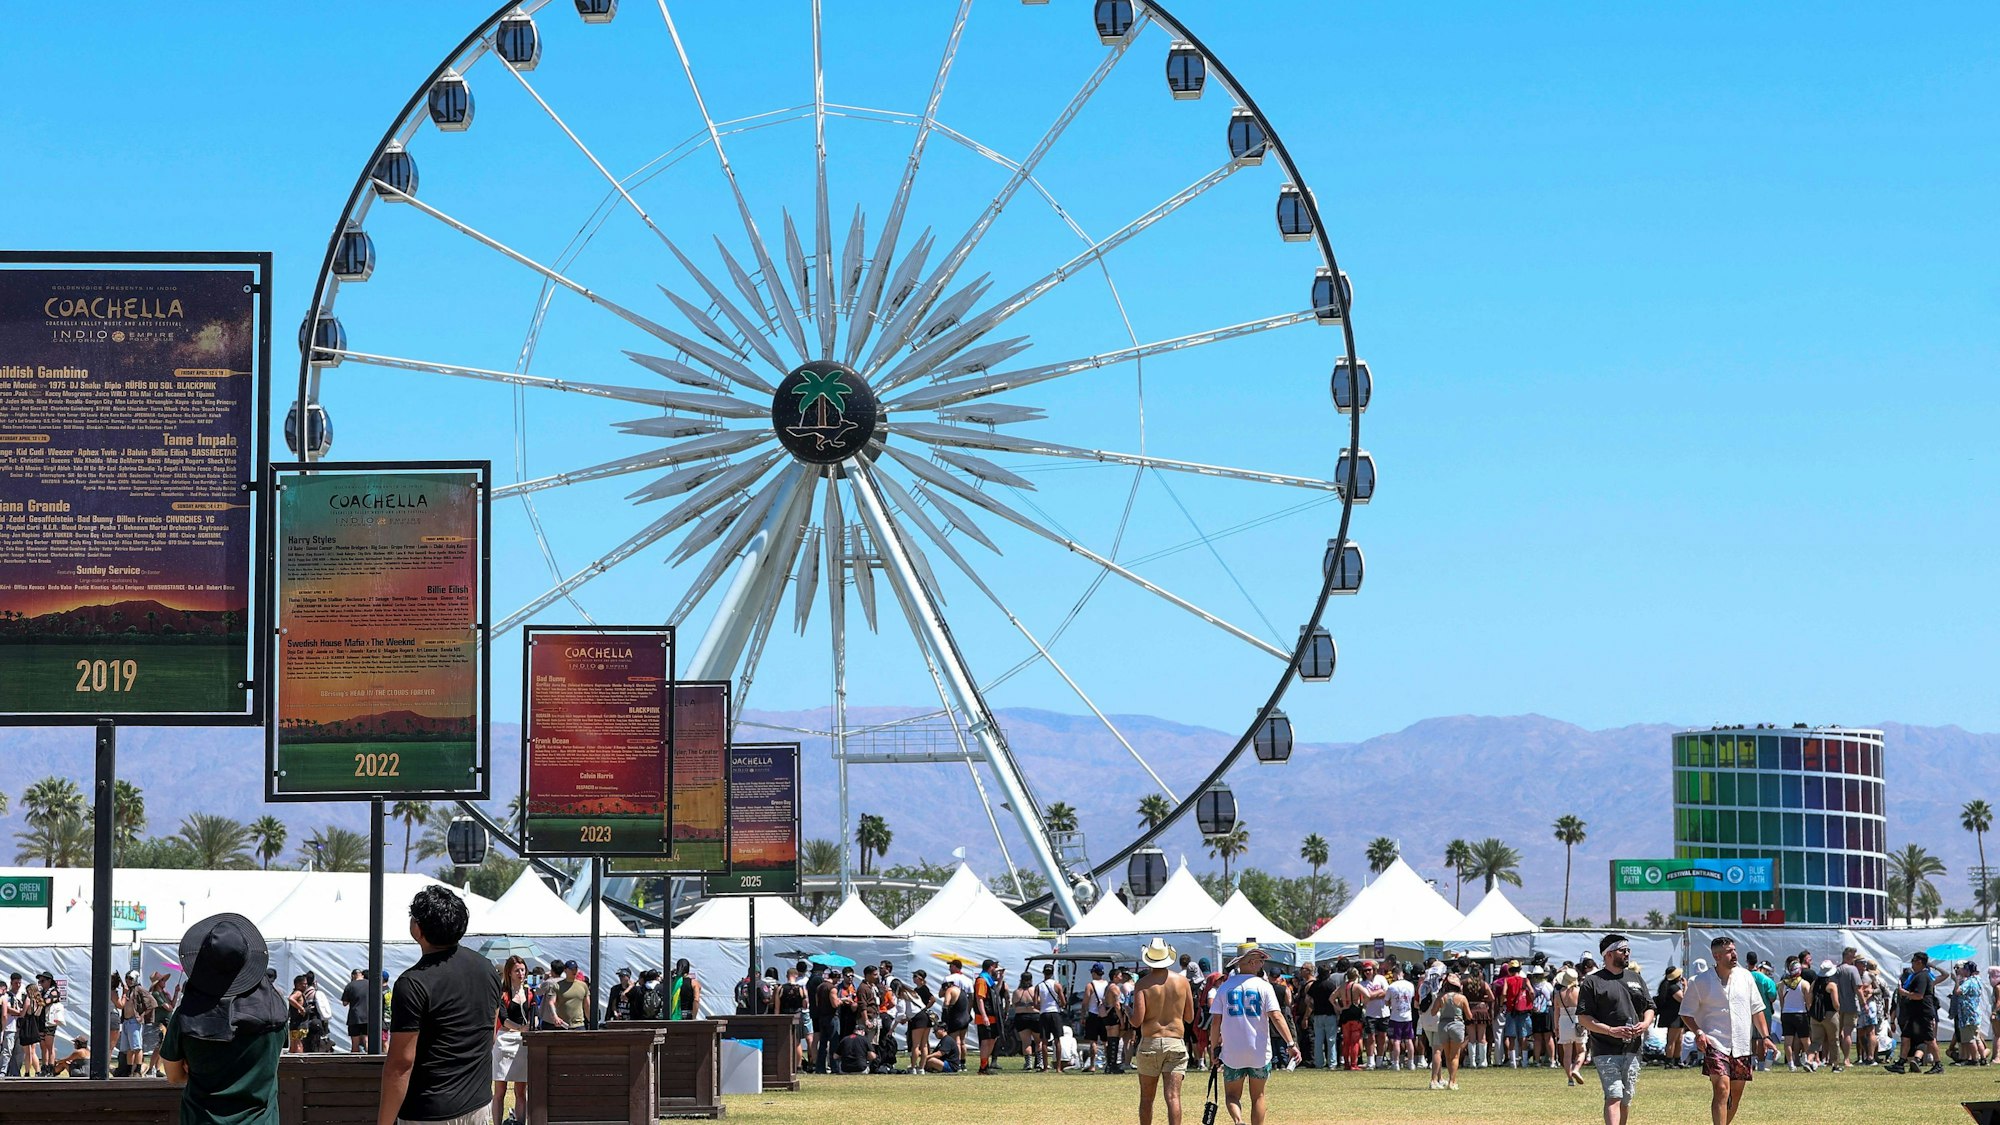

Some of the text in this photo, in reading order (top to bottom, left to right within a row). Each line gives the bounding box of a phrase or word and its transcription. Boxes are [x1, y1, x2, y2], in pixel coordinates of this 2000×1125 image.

[44, 297, 184, 319] COACHELLA
[52, 330, 108, 339] INDIO
[38, 366, 88, 378] Gambino
[105, 382, 121, 390] Diplo
[163, 433, 237, 448] Tame Impala
[78, 448, 98, 457] Aphex
[28, 499, 70, 512] Grande
[330, 494, 427, 509] COACHELLA
[92, 515, 113, 524] Bunny
[289, 536, 336, 545] Harry Styles
[76, 565, 106, 576] Sunday
[108, 565, 140, 574] Service
[565, 648, 633, 658] COACHELLA
[75, 660, 138, 692] 2019
[354, 753, 400, 776] 2022
[580, 826, 612, 842] 2023
[1621, 866, 1641, 874] GREEN
[1667, 870, 1721, 880] FESTIVAL ENTRANCE
[1749, 866, 1765, 874] BLUE
[740, 876, 761, 887] 2025
[1623, 876, 1640, 885] PATH
[20, 883, 40, 891] GREEN
[1228, 990, 1262, 1017] 93
